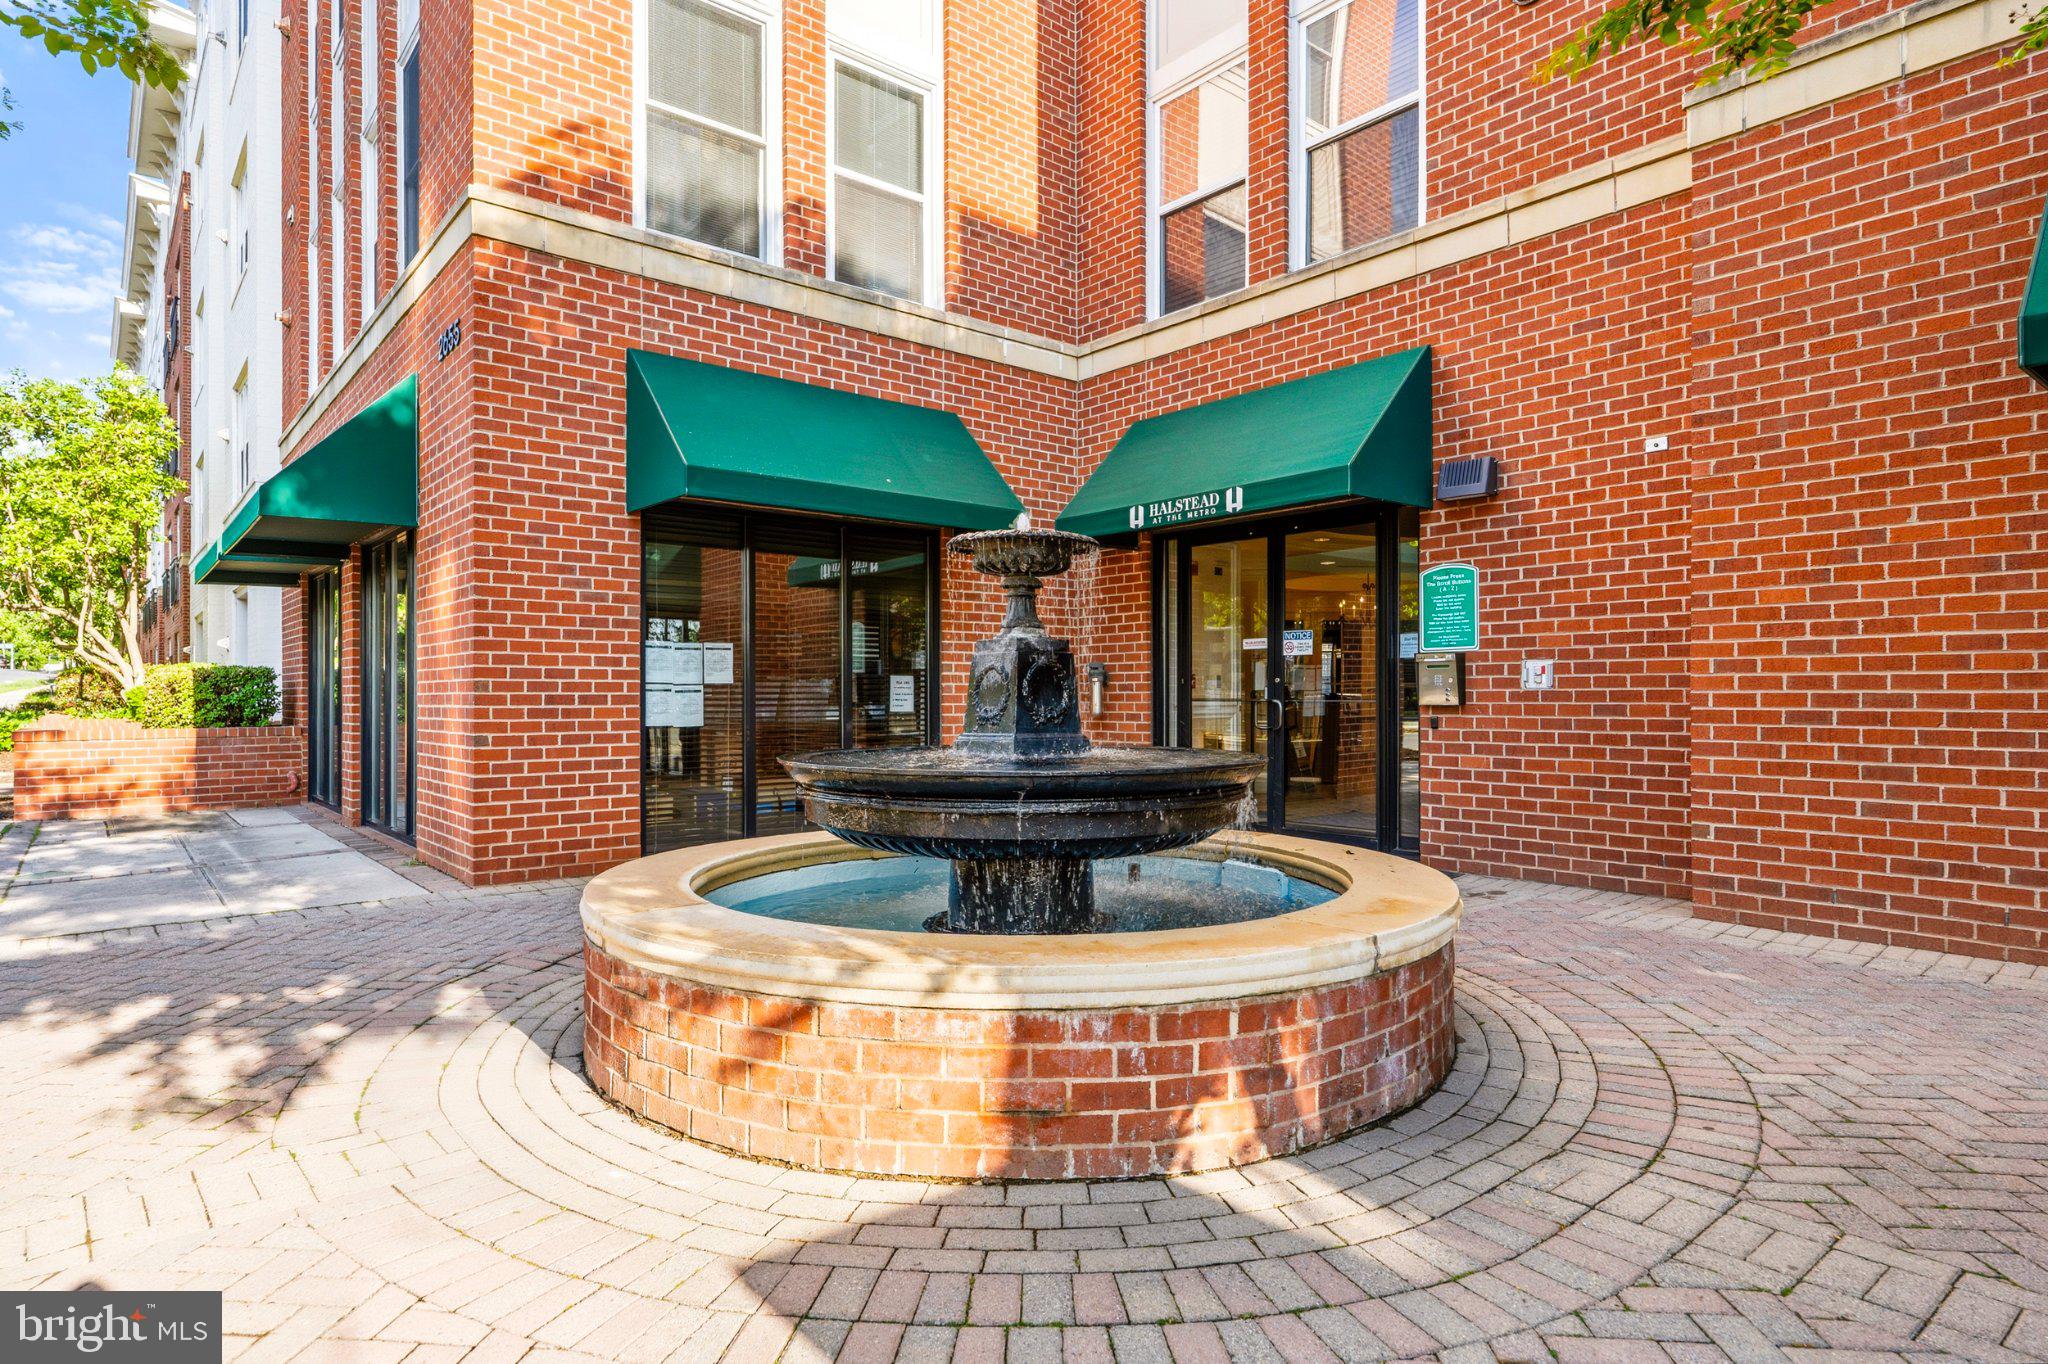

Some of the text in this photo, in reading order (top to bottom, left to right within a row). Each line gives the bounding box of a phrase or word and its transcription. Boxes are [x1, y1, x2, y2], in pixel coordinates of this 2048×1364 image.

[438, 317, 461, 362] 2655
[1149, 493, 1220, 517] HALSTEAD
[1152, 508, 1217, 524] AT THE METRO
[1284, 632, 1311, 640] NOTICE
